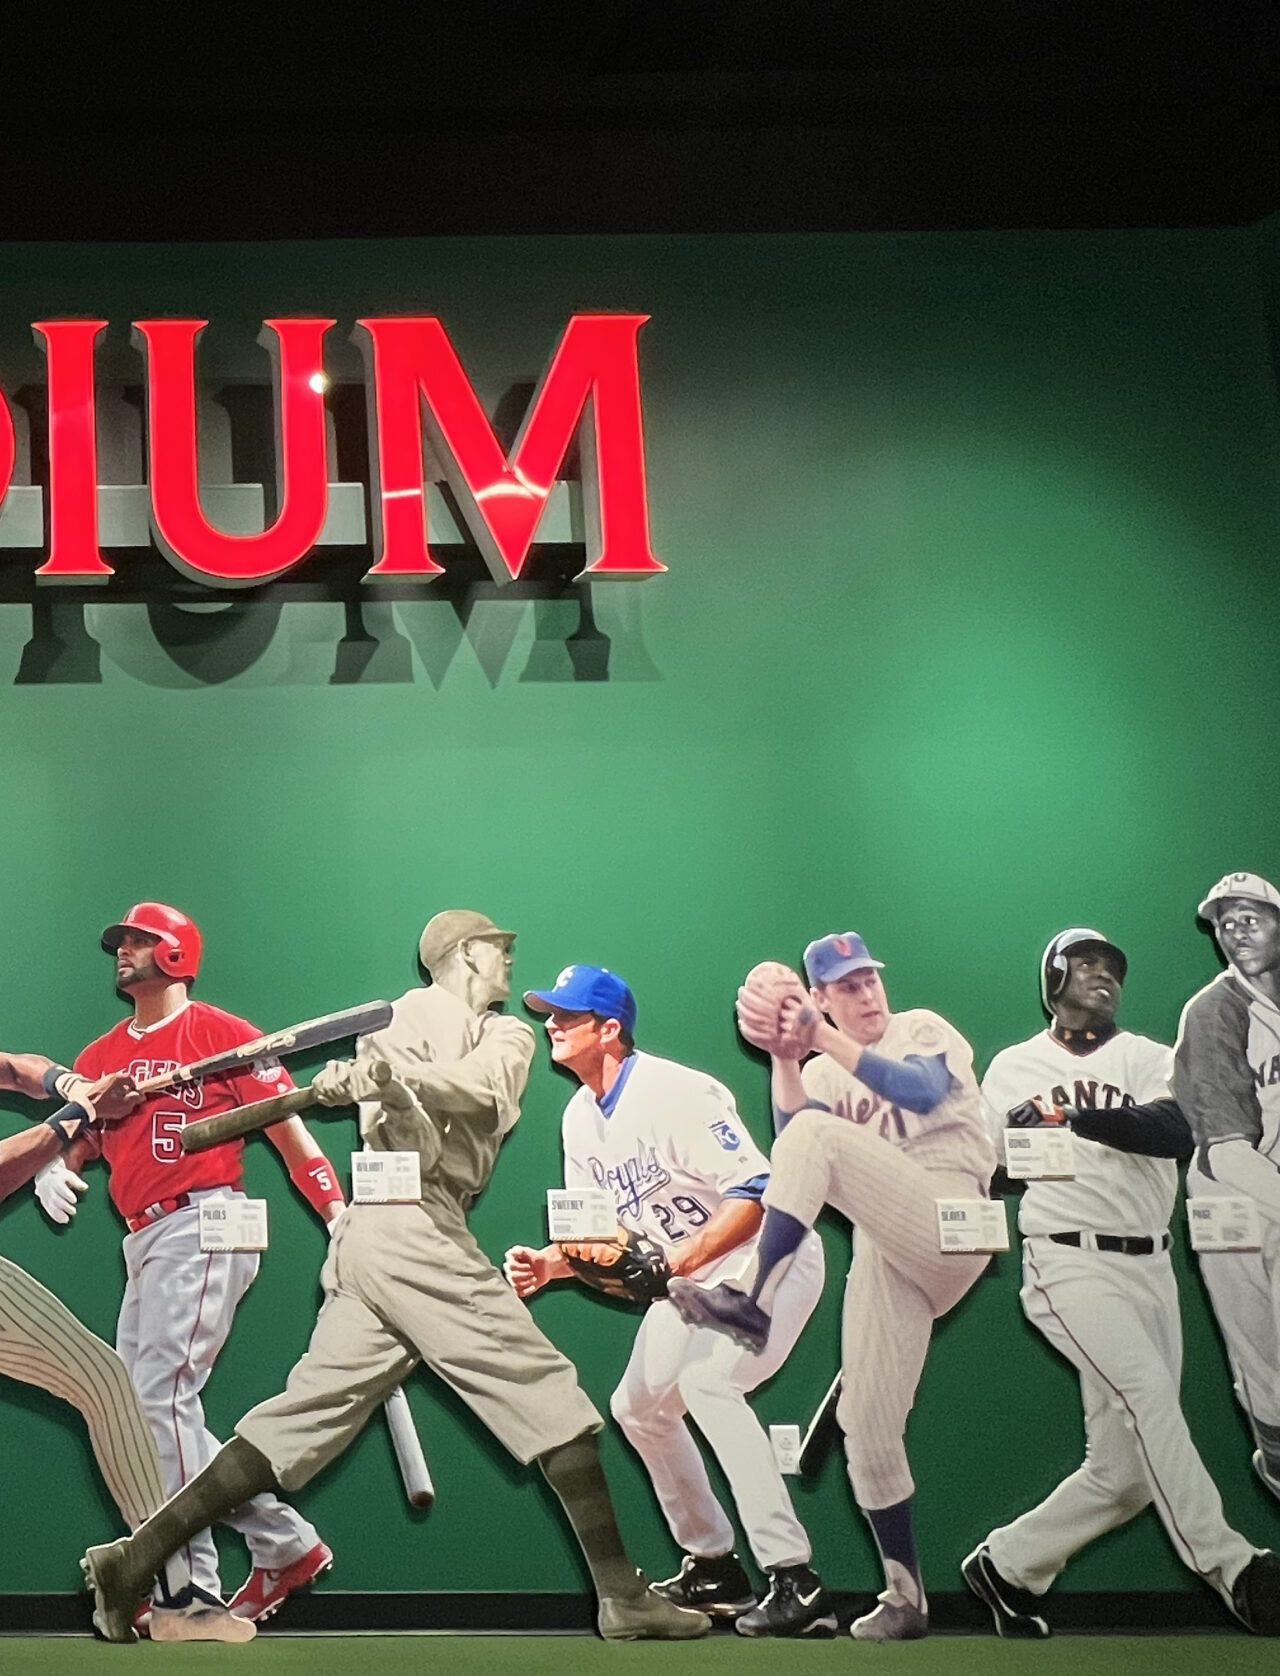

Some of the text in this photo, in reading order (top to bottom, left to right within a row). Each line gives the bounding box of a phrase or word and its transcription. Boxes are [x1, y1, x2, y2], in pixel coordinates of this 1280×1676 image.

[152, 1111, 186, 1164] 5
[317, 1171, 334, 1192] 5
[551, 1199, 584, 1211] SWEENEY
[587, 1146, 666, 1220] Royals
[651, 1195, 712, 1243] 29
